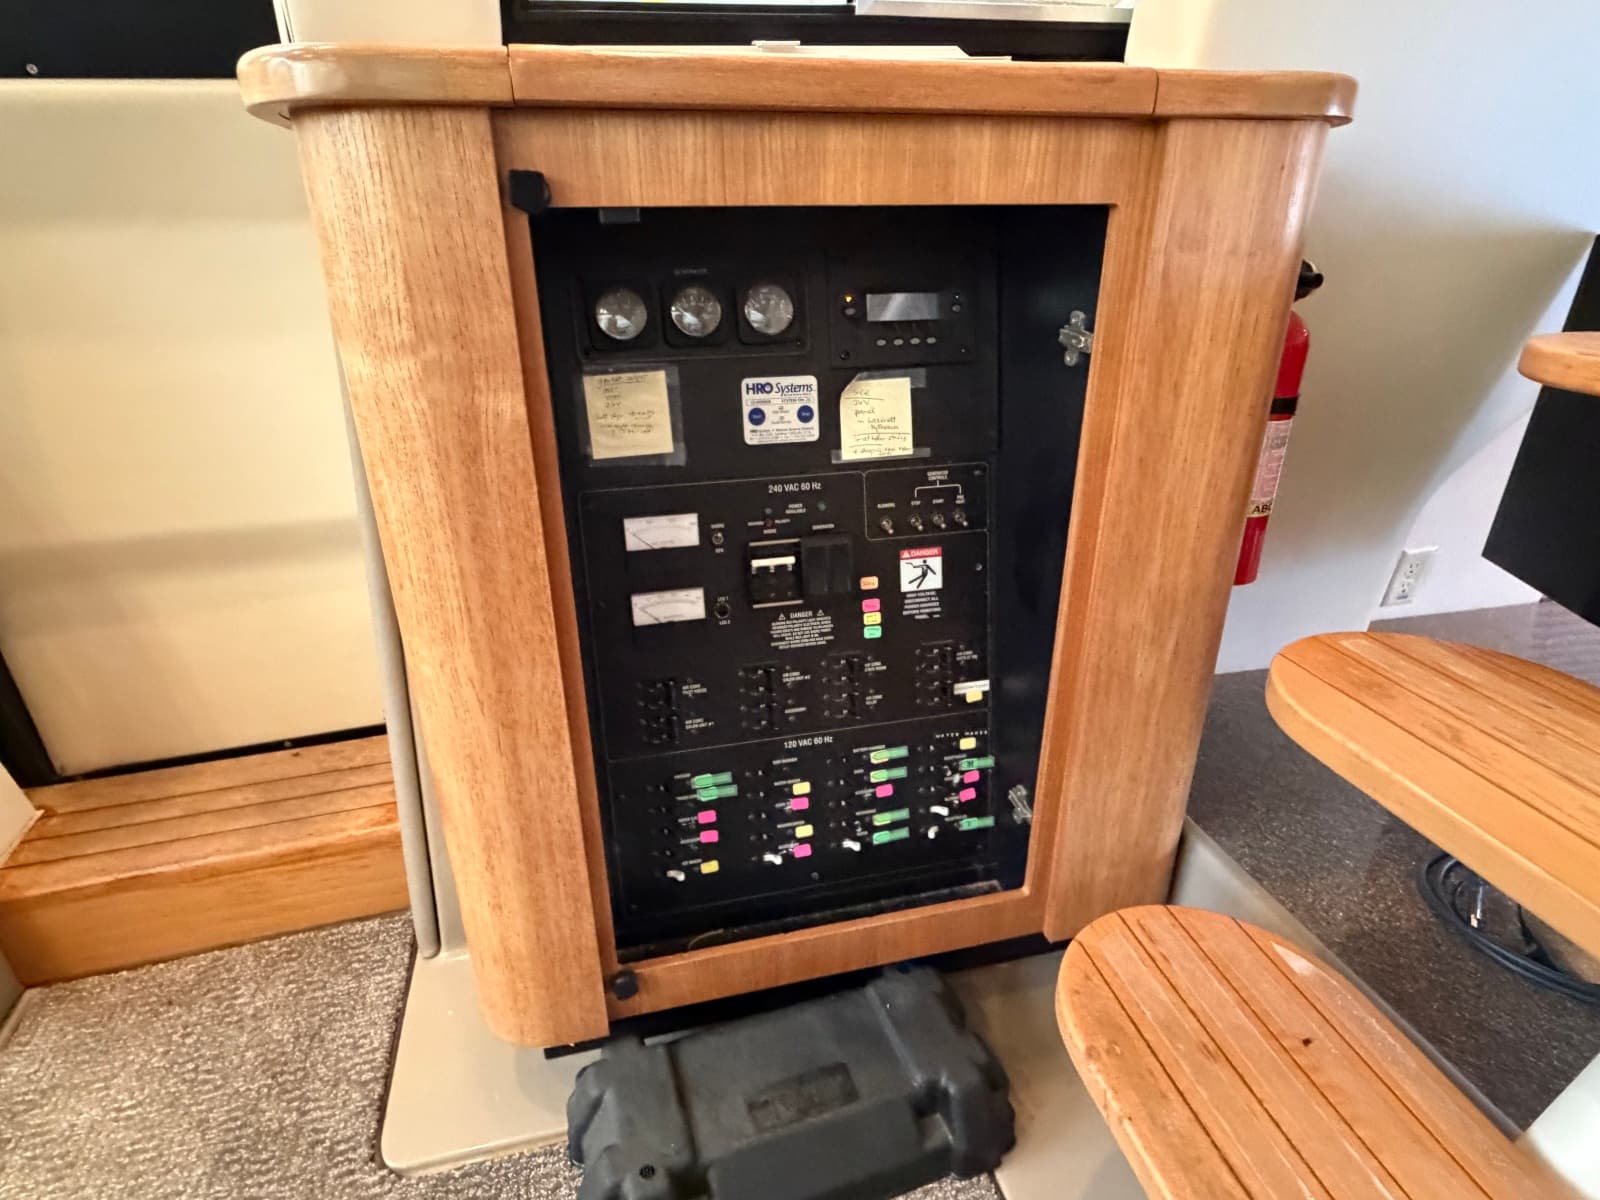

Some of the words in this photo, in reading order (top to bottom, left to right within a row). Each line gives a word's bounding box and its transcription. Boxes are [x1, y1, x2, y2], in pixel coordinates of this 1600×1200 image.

[746, 382, 773, 395] HRO
[774, 382, 813, 396] Systems
[768, 484, 783, 493] 240
[784, 483, 800, 492] VAC
[801, 482, 811, 491] 60
[812, 481, 822, 490] Hz
[790, 610, 813, 619] DANGER
[784, 741, 797, 749] 120
[798, 739, 813, 747] VAC
[813, 737, 823, 745] 60
